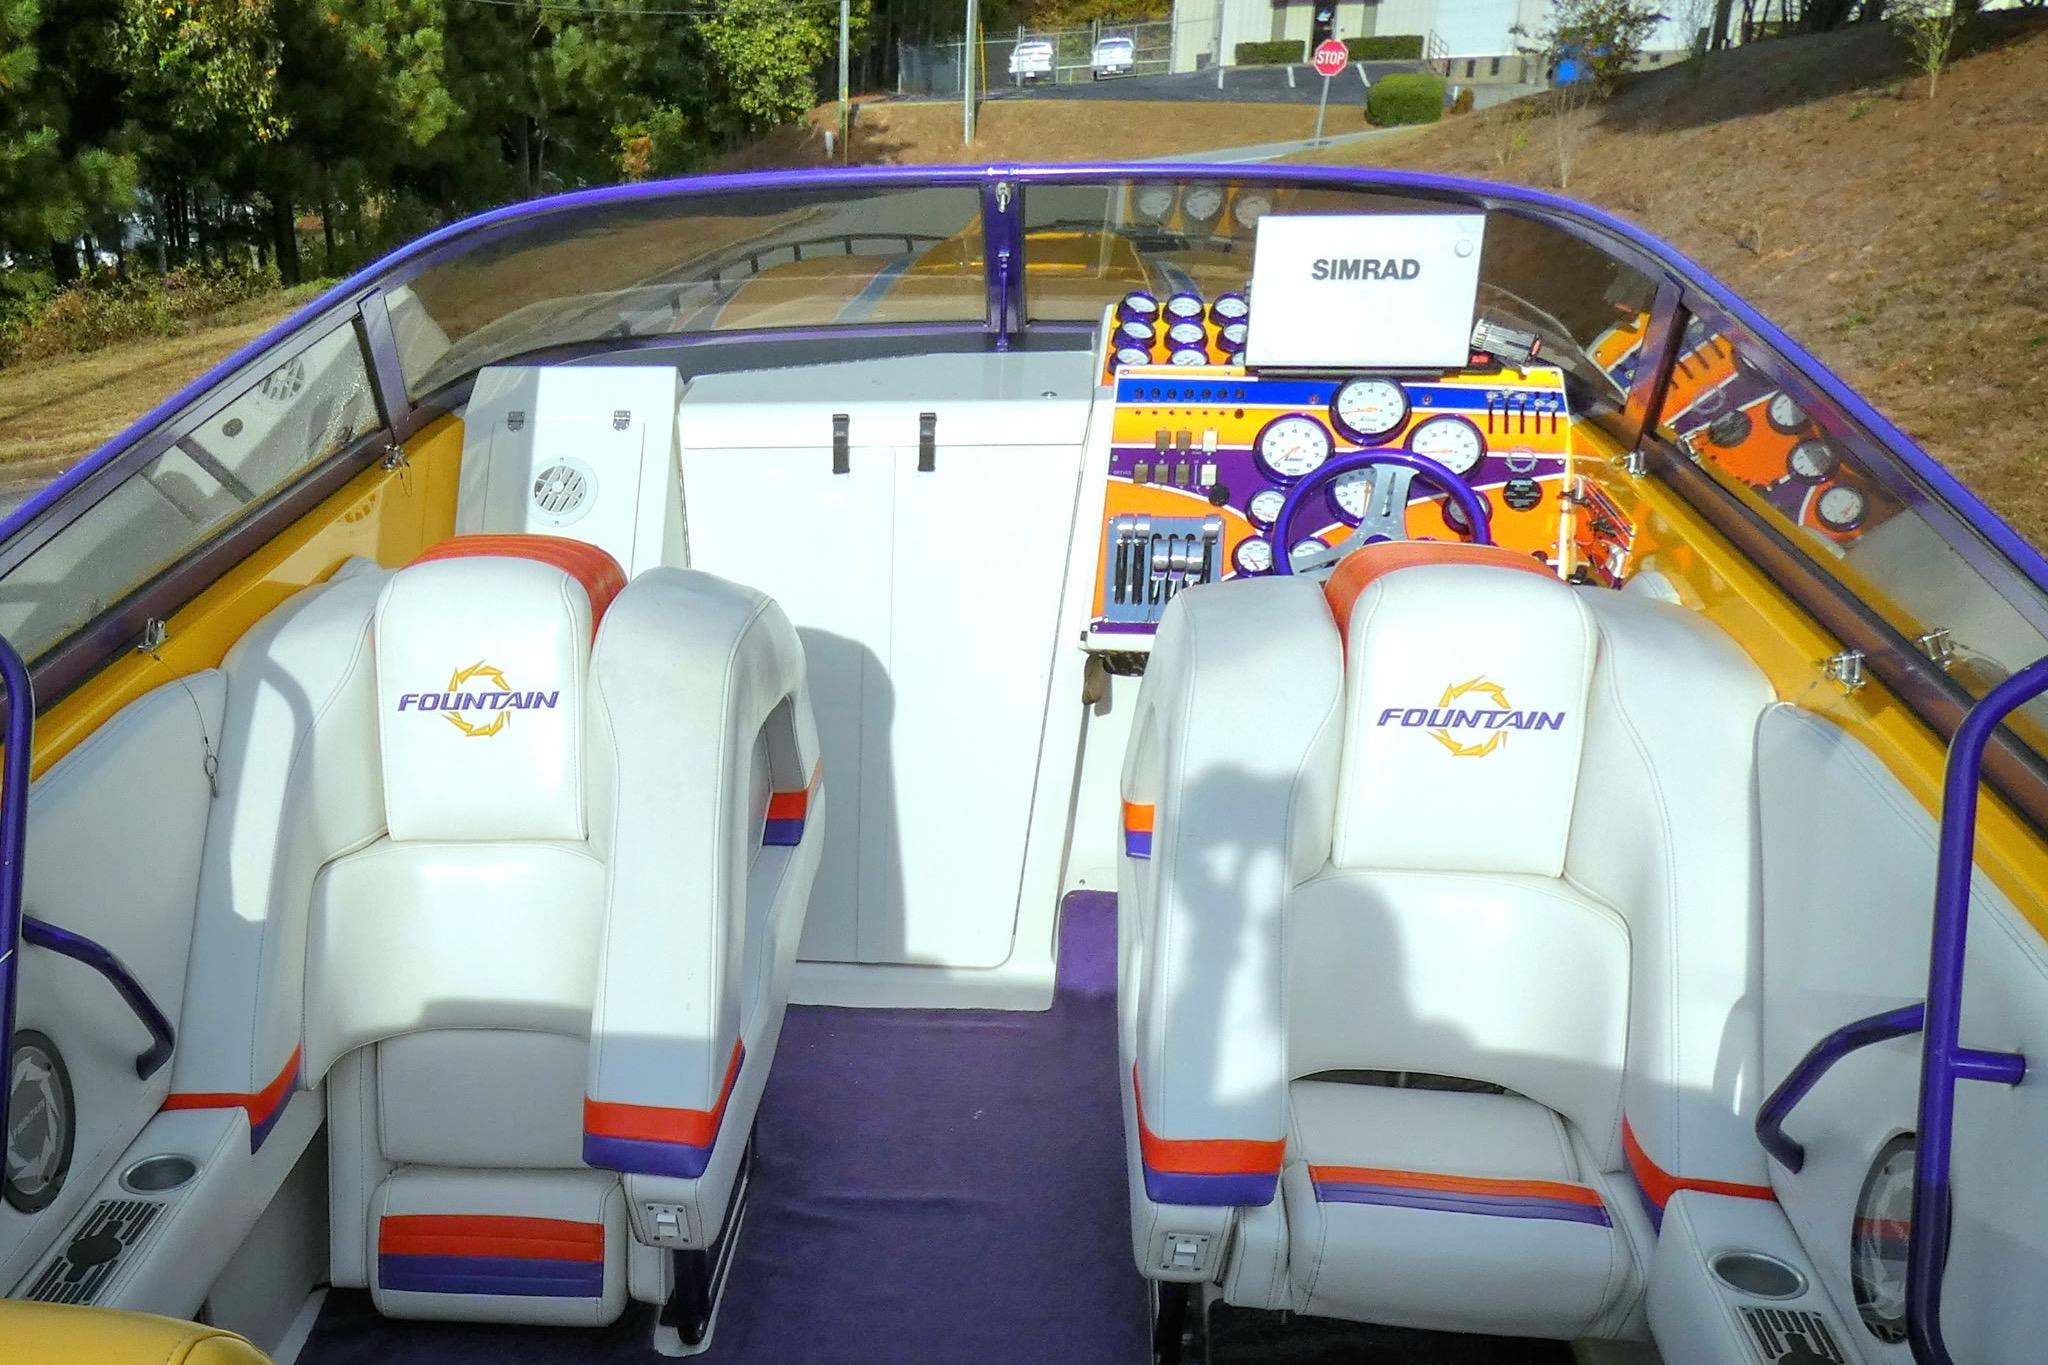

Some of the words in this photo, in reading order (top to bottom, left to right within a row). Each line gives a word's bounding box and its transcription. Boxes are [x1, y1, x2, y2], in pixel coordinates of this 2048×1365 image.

[1317, 51, 1345, 65] STOP
[1311, 258, 1421, 281] SIMRAD
[398, 691, 559, 712] FOUNTAIN
[1377, 708, 1566, 730] FOUNTAIN
